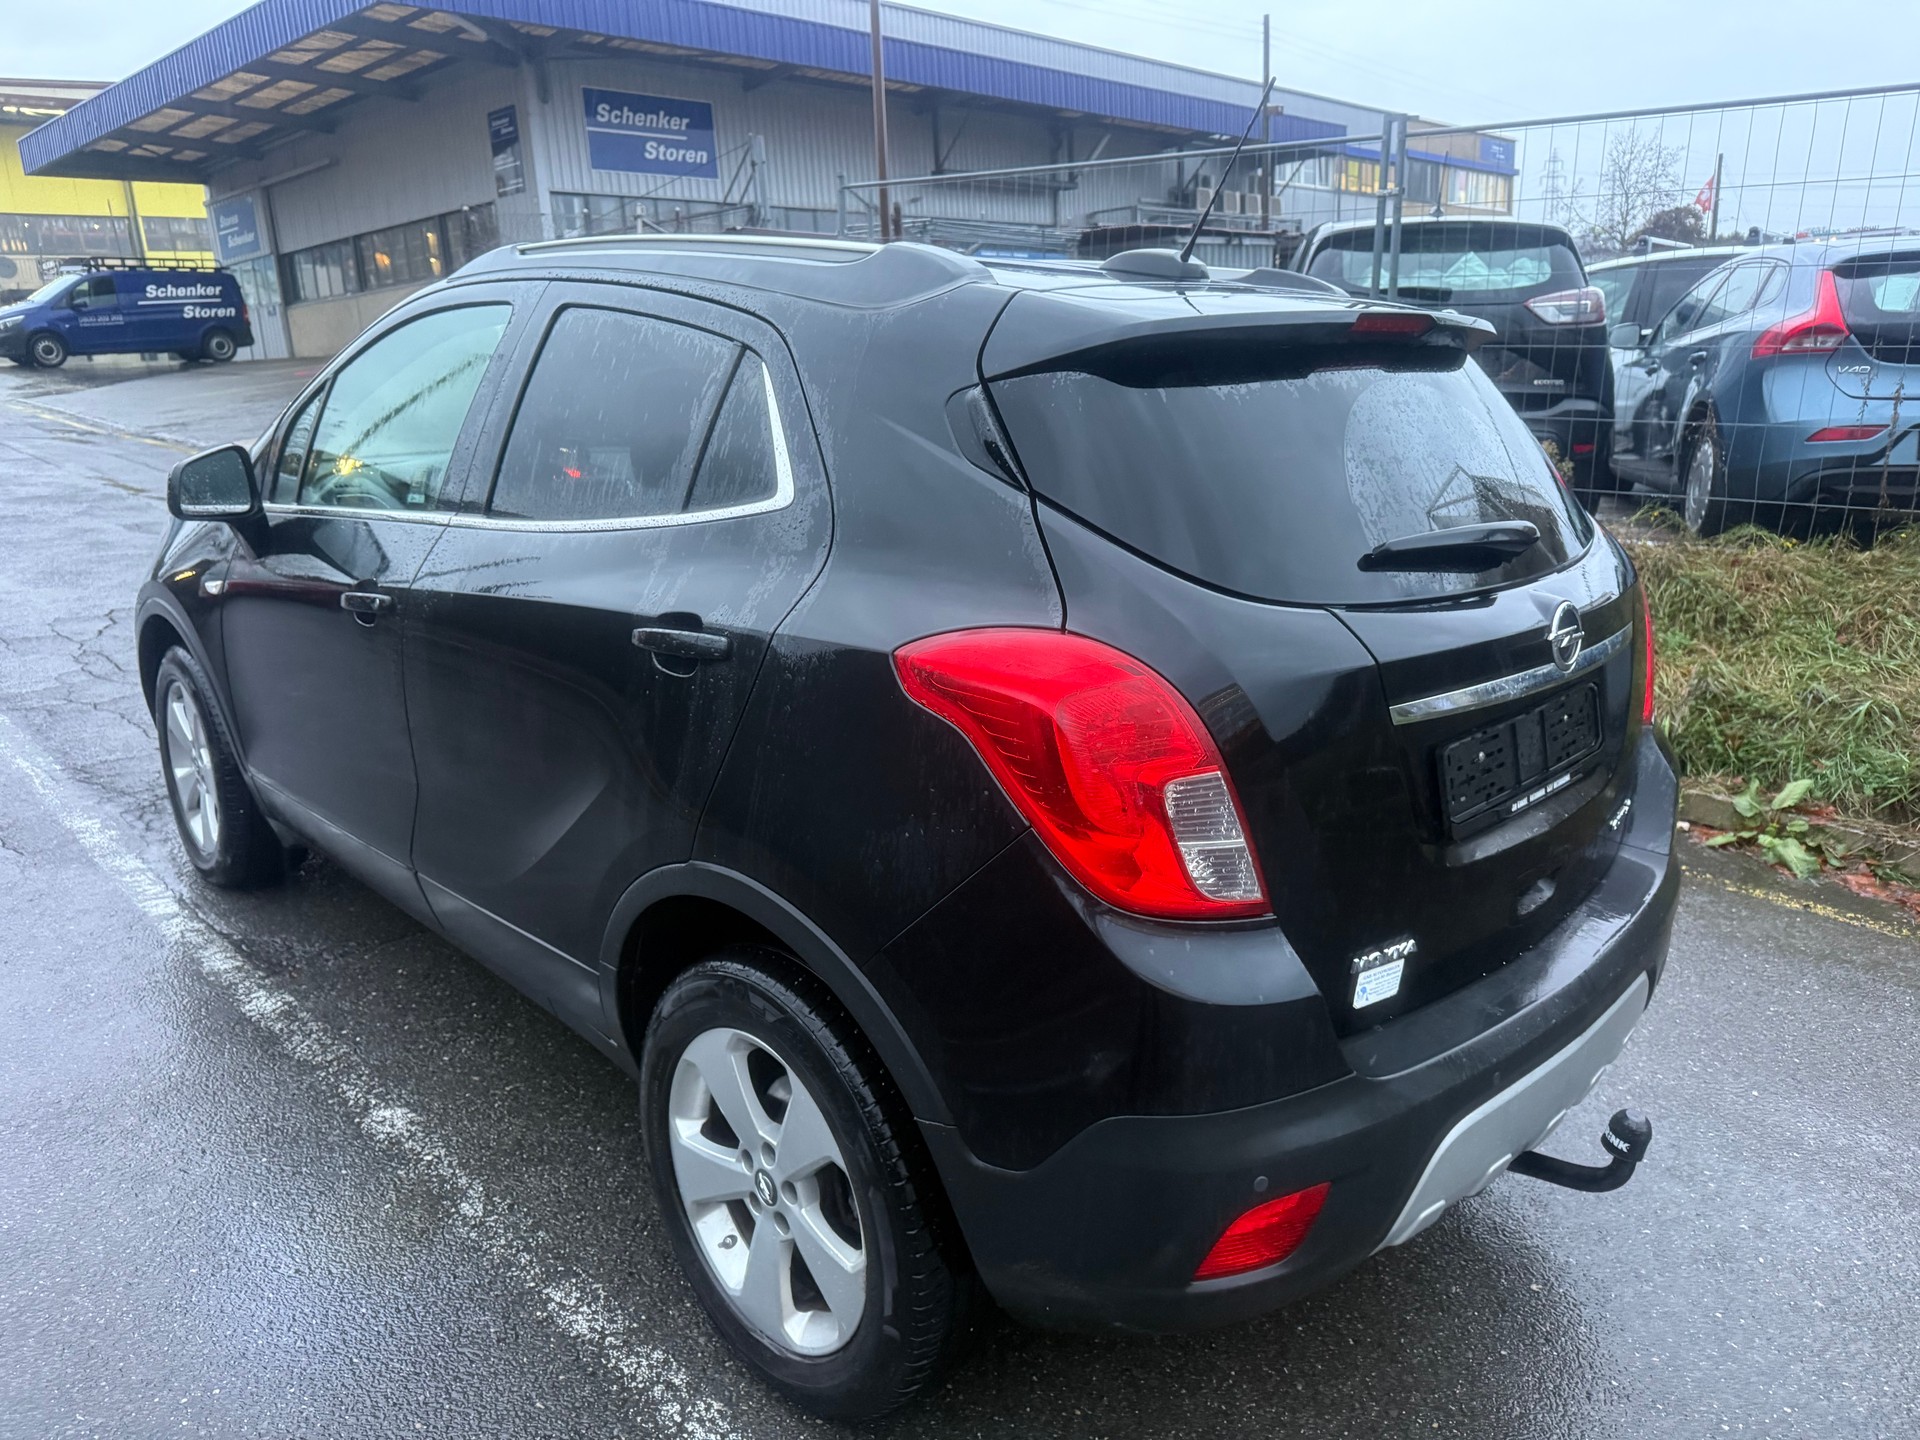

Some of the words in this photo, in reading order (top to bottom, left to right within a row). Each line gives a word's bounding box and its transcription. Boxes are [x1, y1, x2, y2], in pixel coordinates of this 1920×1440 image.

[596, 103, 690, 130] Schenker
[644, 141, 707, 164] Storen
[145, 283, 222, 298] Schenker
[183, 305, 236, 319] Storen
[1838, 365, 1870, 373] V40
